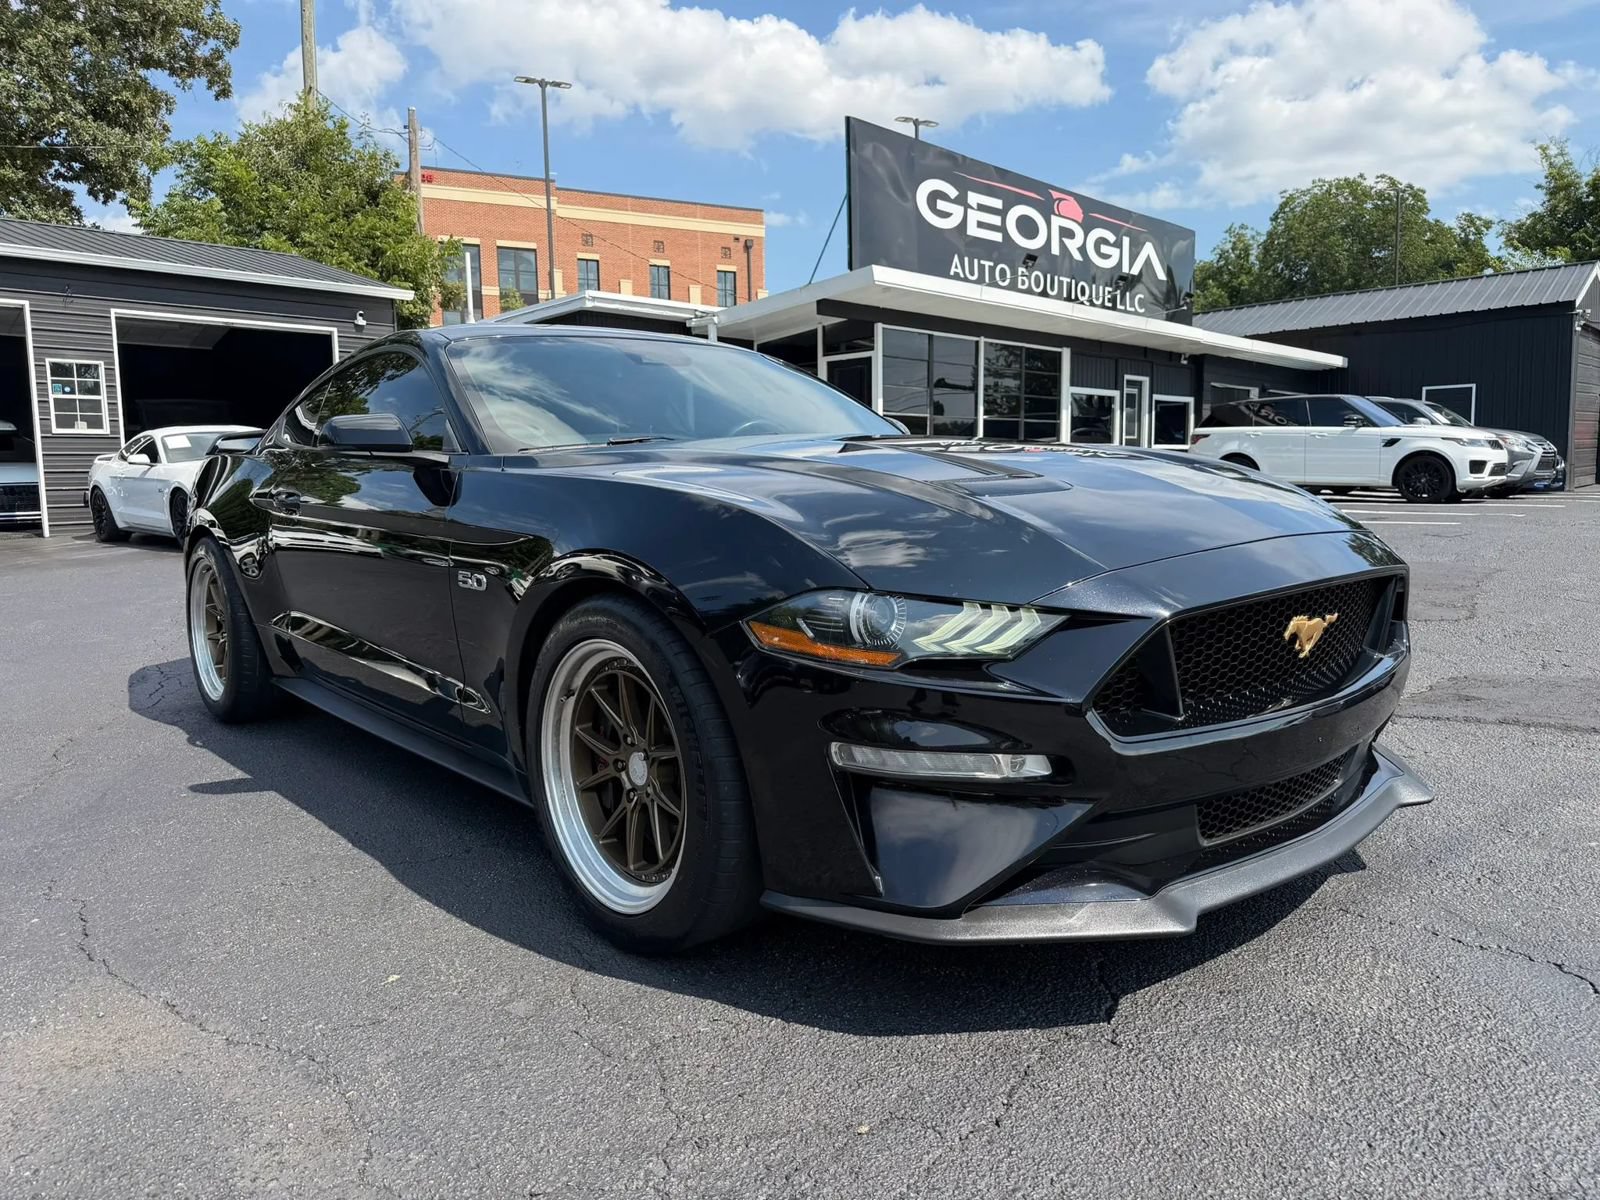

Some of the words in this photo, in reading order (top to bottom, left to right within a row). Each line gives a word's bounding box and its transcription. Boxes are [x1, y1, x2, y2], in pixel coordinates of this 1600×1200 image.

[915, 178, 1167, 281] GEORGIA
[949, 253, 1011, 287] AUTO
[1017, 266, 1113, 307] BOUTIQUE
[1116, 290, 1146, 313] LLC
